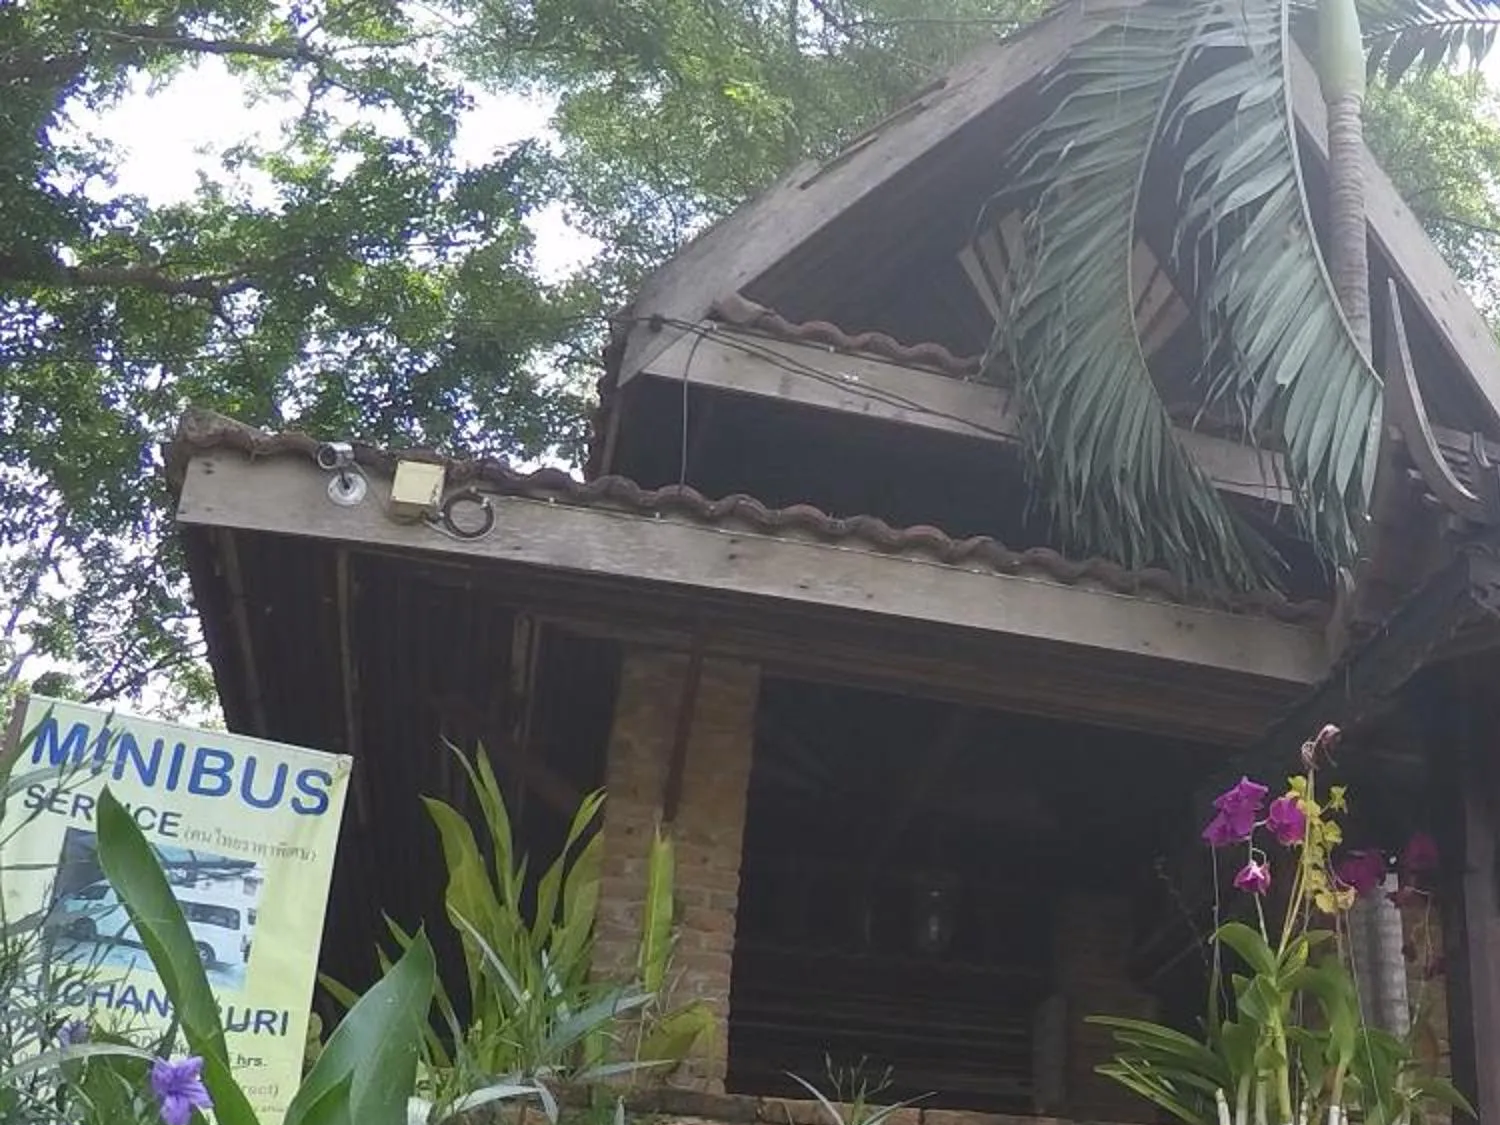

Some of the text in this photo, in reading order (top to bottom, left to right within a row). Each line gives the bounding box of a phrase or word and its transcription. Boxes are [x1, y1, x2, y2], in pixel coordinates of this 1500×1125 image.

[31, 717, 333, 817] MINIBUS
[24, 783, 182, 838] SERCE
[61, 979, 290, 1037] CHANURI
